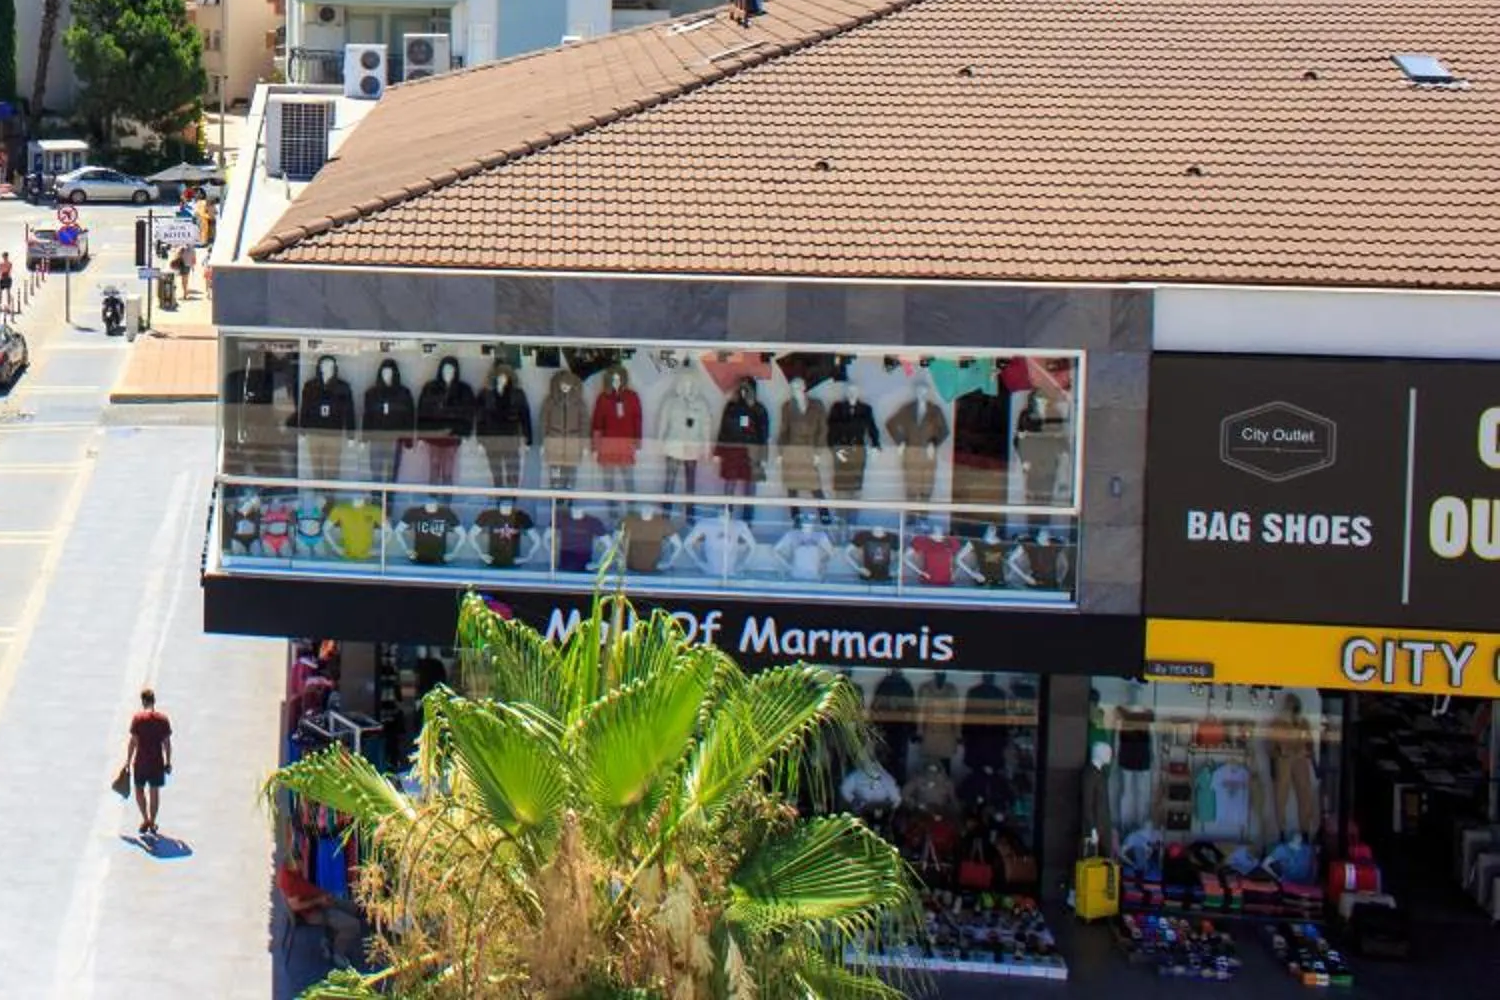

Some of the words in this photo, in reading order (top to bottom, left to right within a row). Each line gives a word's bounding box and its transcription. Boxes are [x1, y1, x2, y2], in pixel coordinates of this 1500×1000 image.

[1241, 427, 1269, 443] City
[1272, 428, 1316, 443] Outlet
[1187, 510, 1251, 542] BAG
[1261, 513, 1373, 547] SHOES
[739, 616, 954, 661] Marmaris
[1342, 636, 1477, 688] CITY
